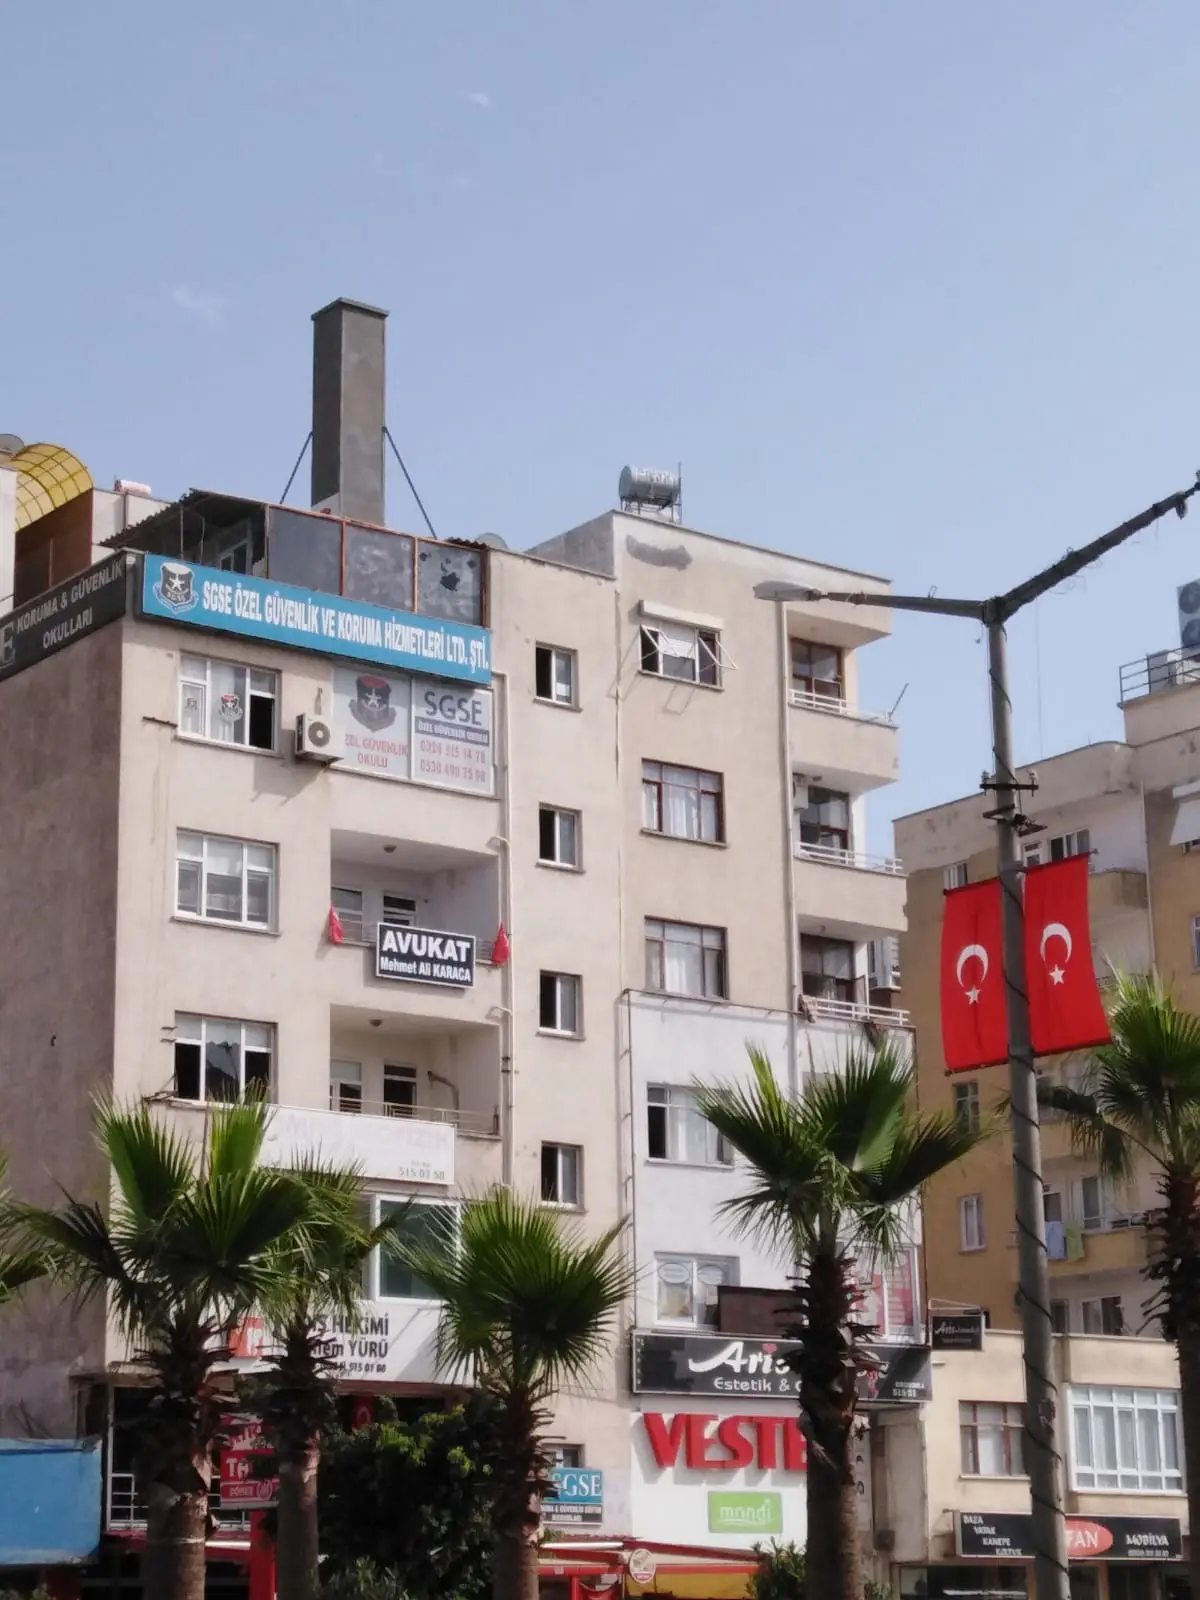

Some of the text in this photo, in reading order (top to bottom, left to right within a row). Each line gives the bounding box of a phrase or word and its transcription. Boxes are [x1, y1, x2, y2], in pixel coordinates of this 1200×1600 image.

[17, 598, 58, 634] KORUMA
[60, 591, 68, 609] &
[42, 607, 93, 649] OKULLARI
[203, 580, 489, 674] SGSE ÖZEL GÜVENLİK VE KORUMA HİZMETLERİ LTD. ŞTİ.
[424, 691, 483, 726] SGSE
[382, 930, 470, 962] AVUKAT
[380, 957, 472, 983] Mehmet Ali KARACA
[348, 1338, 388, 1358] YÜRÜ
[714, 1377, 772, 1392] Estetik
[778, 1378, 790, 1392] &
[643, 1412, 807, 1473] VESTE
[1066, 1530, 1169, 1549] FAN MOBİLYA
